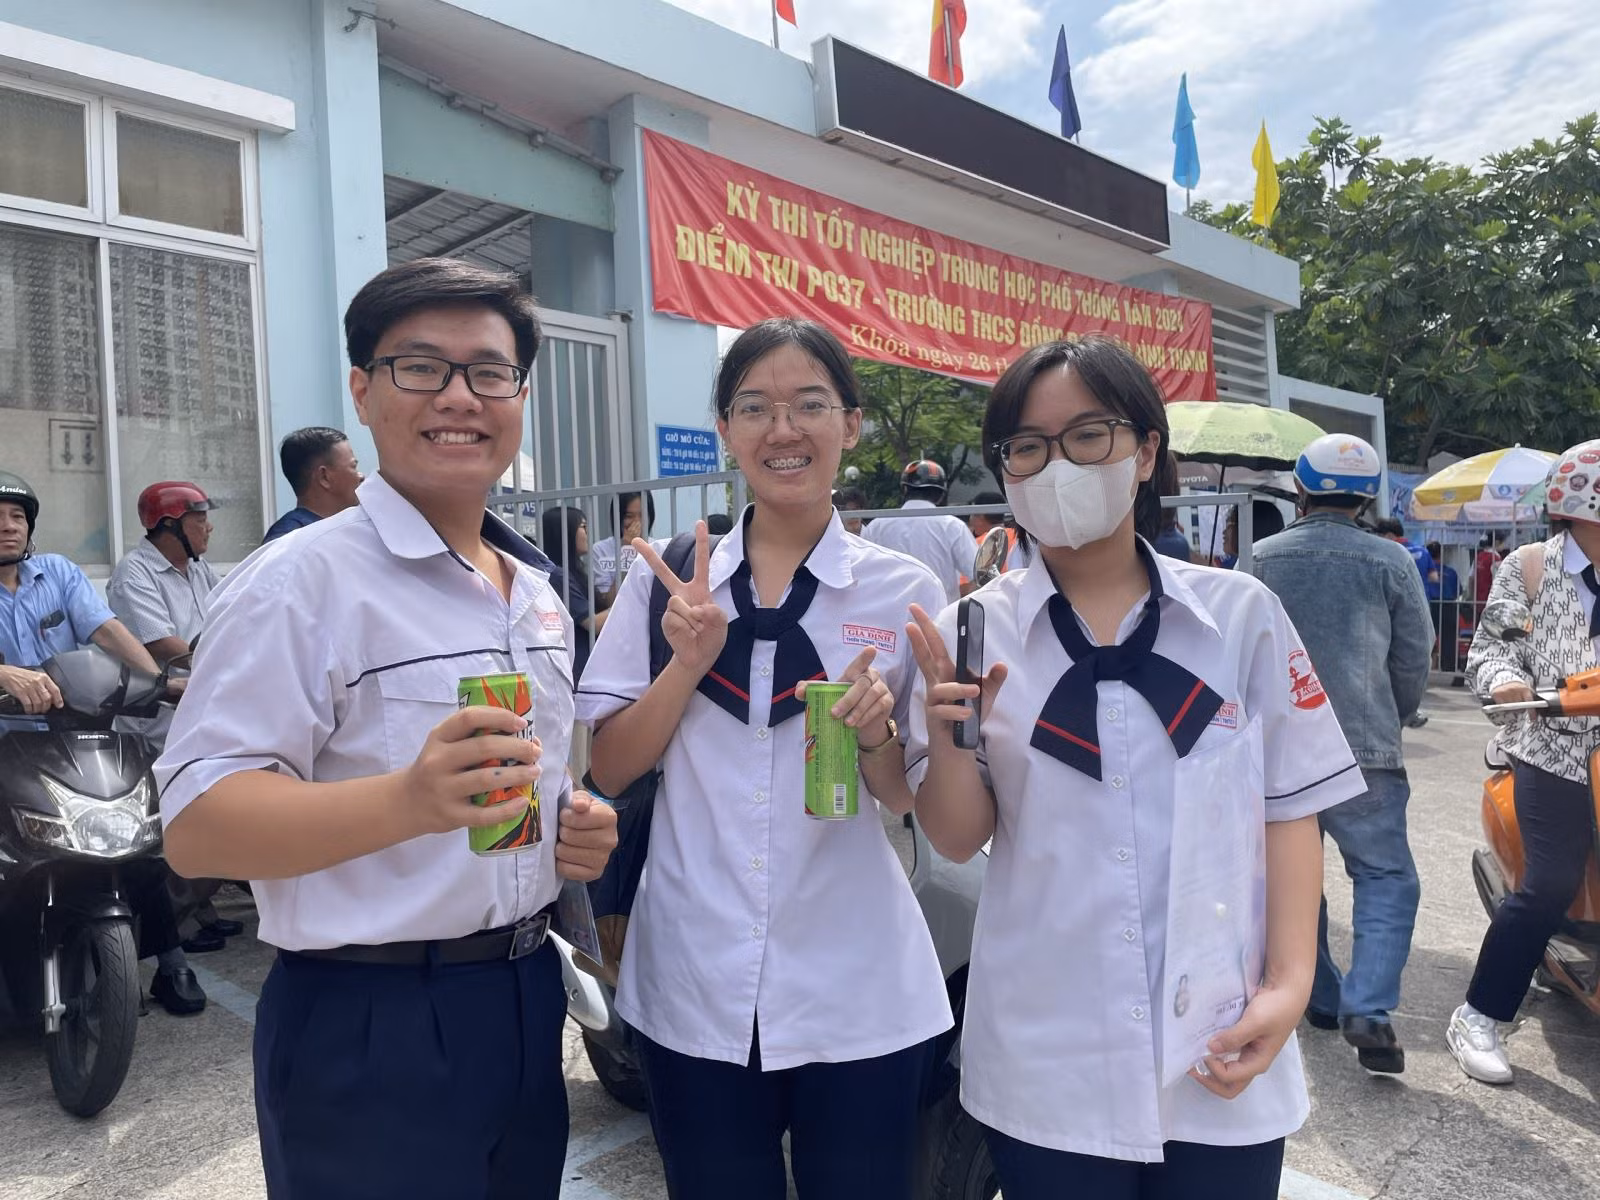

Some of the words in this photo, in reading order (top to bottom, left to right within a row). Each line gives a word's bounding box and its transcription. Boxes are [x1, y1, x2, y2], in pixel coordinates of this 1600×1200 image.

[676, 222, 752, 278] ĐIỂM
[756, 251, 801, 293] THI
[886, 287, 965, 336] TRƯỜNG
[971, 309, 1016, 347] THCS
[726, 180, 760, 223] KỲ
[768, 195, 808, 238] THI
[813, 208, 855, 251] TỐT
[860, 227, 935, 281] NGHIỆP
[940, 252, 999, 295] TRUNG
[1003, 270, 1036, 307] HỌC
[1041, 276, 1072, 312] PHỔ
[1075, 288, 1121, 322] THÔNG
[1155, 307, 1184, 332] 2024
[917, 346, 965, 371] ngày
[968, 352, 992, 373] 26
[848, 629, 865, 637] GIA
